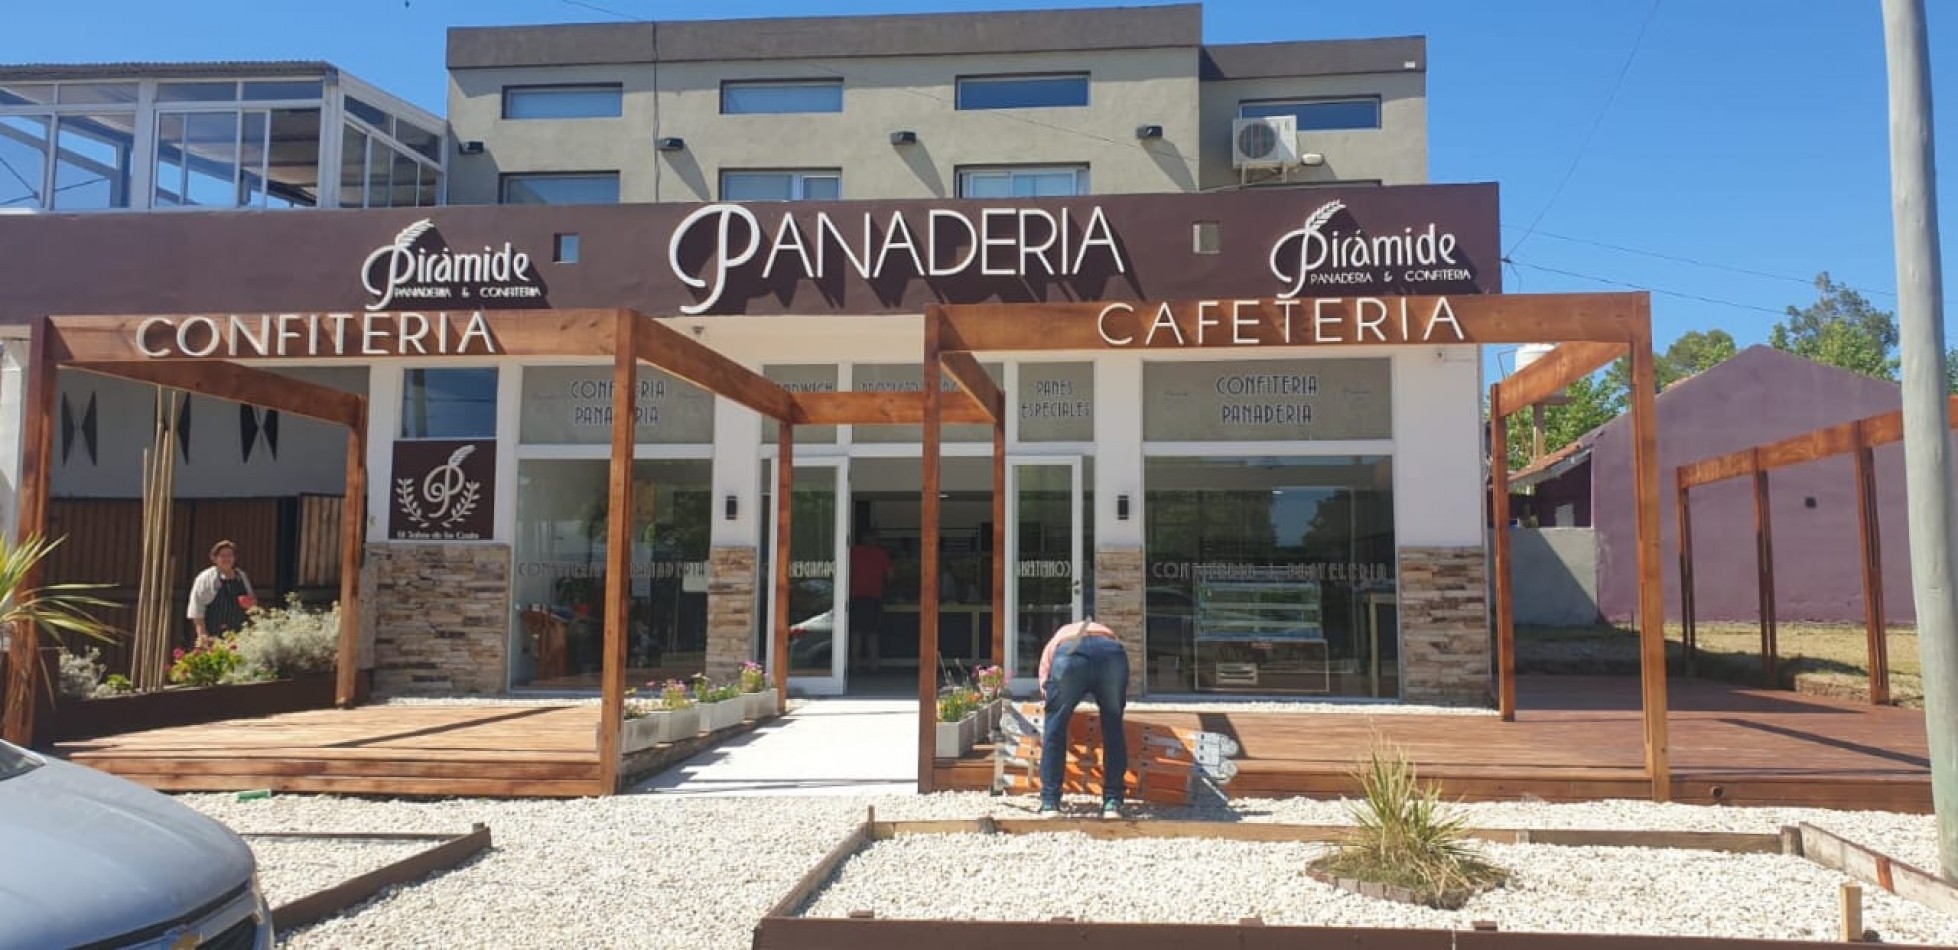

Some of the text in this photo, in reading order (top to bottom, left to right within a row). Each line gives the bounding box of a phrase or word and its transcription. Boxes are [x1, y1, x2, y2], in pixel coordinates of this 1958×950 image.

[669, 204, 1125, 314] PANADERIA
[1310, 269, 1471, 284] PANADERIA & CONFITERIA
[393, 286, 451, 298] PANADERIA
[1097, 296, 1466, 346] CAFETERIA
[135, 311, 496, 357] CONFITERIA
[571, 380, 666, 399] CONFRIA
[1215, 375, 1318, 395] CONFITERIA
[574, 406, 660, 425] PANARIA
[1221, 404, 1313, 423] PANADERIA
